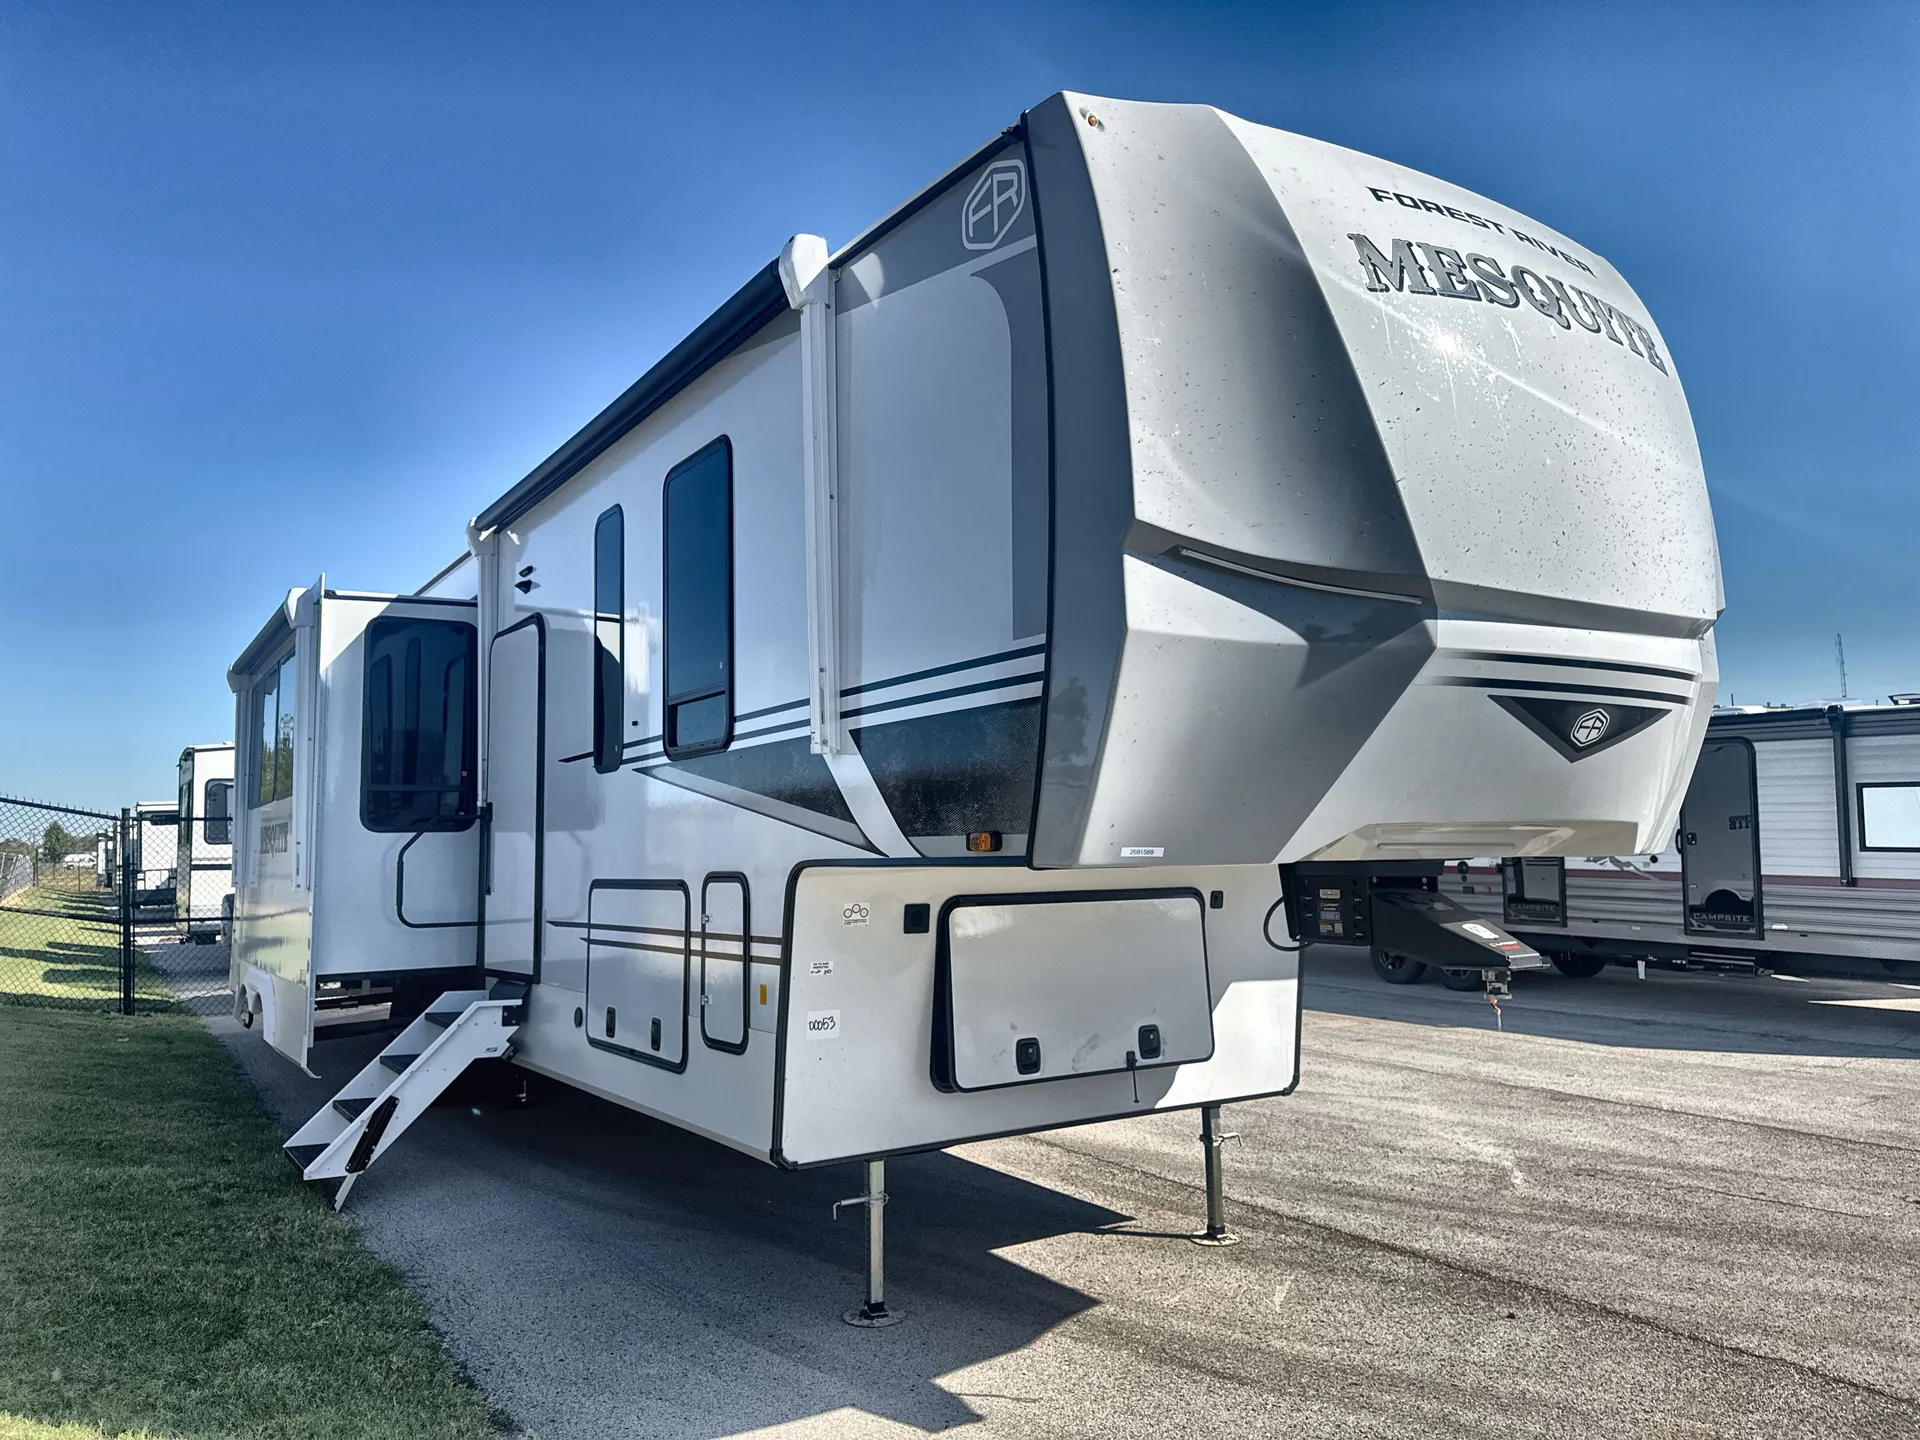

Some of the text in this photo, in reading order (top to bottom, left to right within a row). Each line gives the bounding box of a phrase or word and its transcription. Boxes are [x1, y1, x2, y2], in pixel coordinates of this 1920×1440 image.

[1366, 186, 1599, 279] FOREST RIVER
[1346, 232, 1670, 377] MESQUITE
[1693, 912, 1750, 922] CAMPSITE
[808, 1016, 836, 1031] 00053
